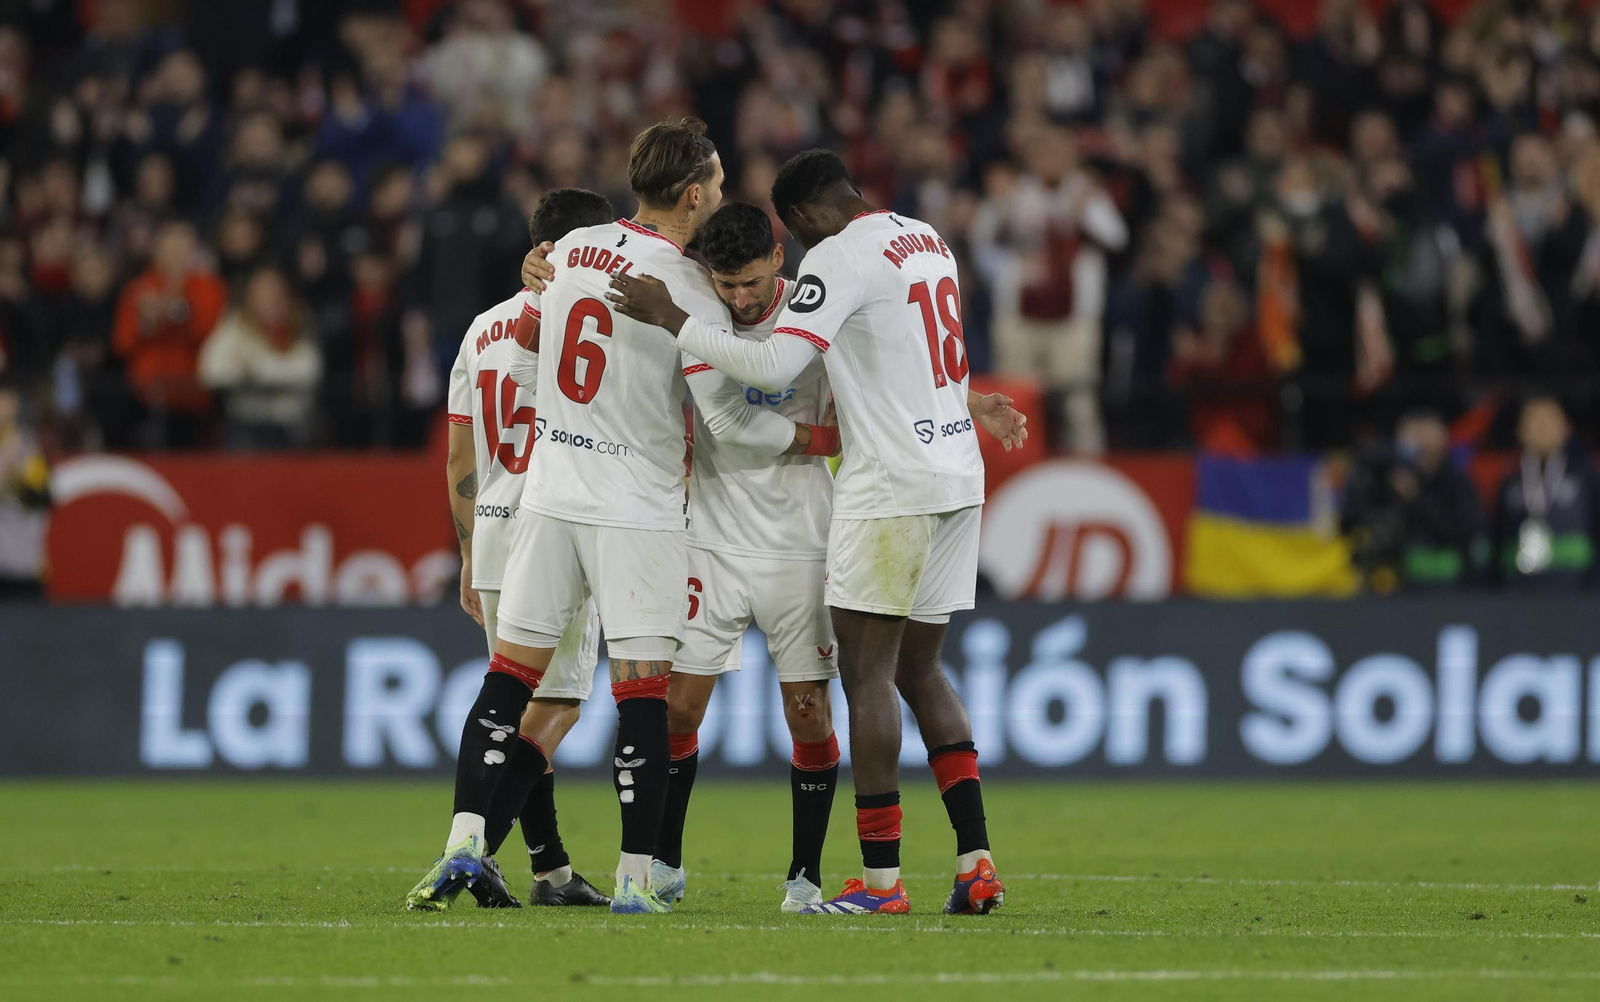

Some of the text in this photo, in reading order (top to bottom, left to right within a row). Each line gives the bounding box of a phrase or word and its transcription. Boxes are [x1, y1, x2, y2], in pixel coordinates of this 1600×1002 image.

[883, 233, 950, 270] AGOUMÉ
[790, 283, 822, 305] JD
[557, 297, 613, 404] 6
[907, 276, 969, 389] 18
[476, 369, 536, 475] 15
[550, 429, 634, 457] SOIOS.com
[140, 638, 311, 768] La
[800, 783, 827, 792] SFC
